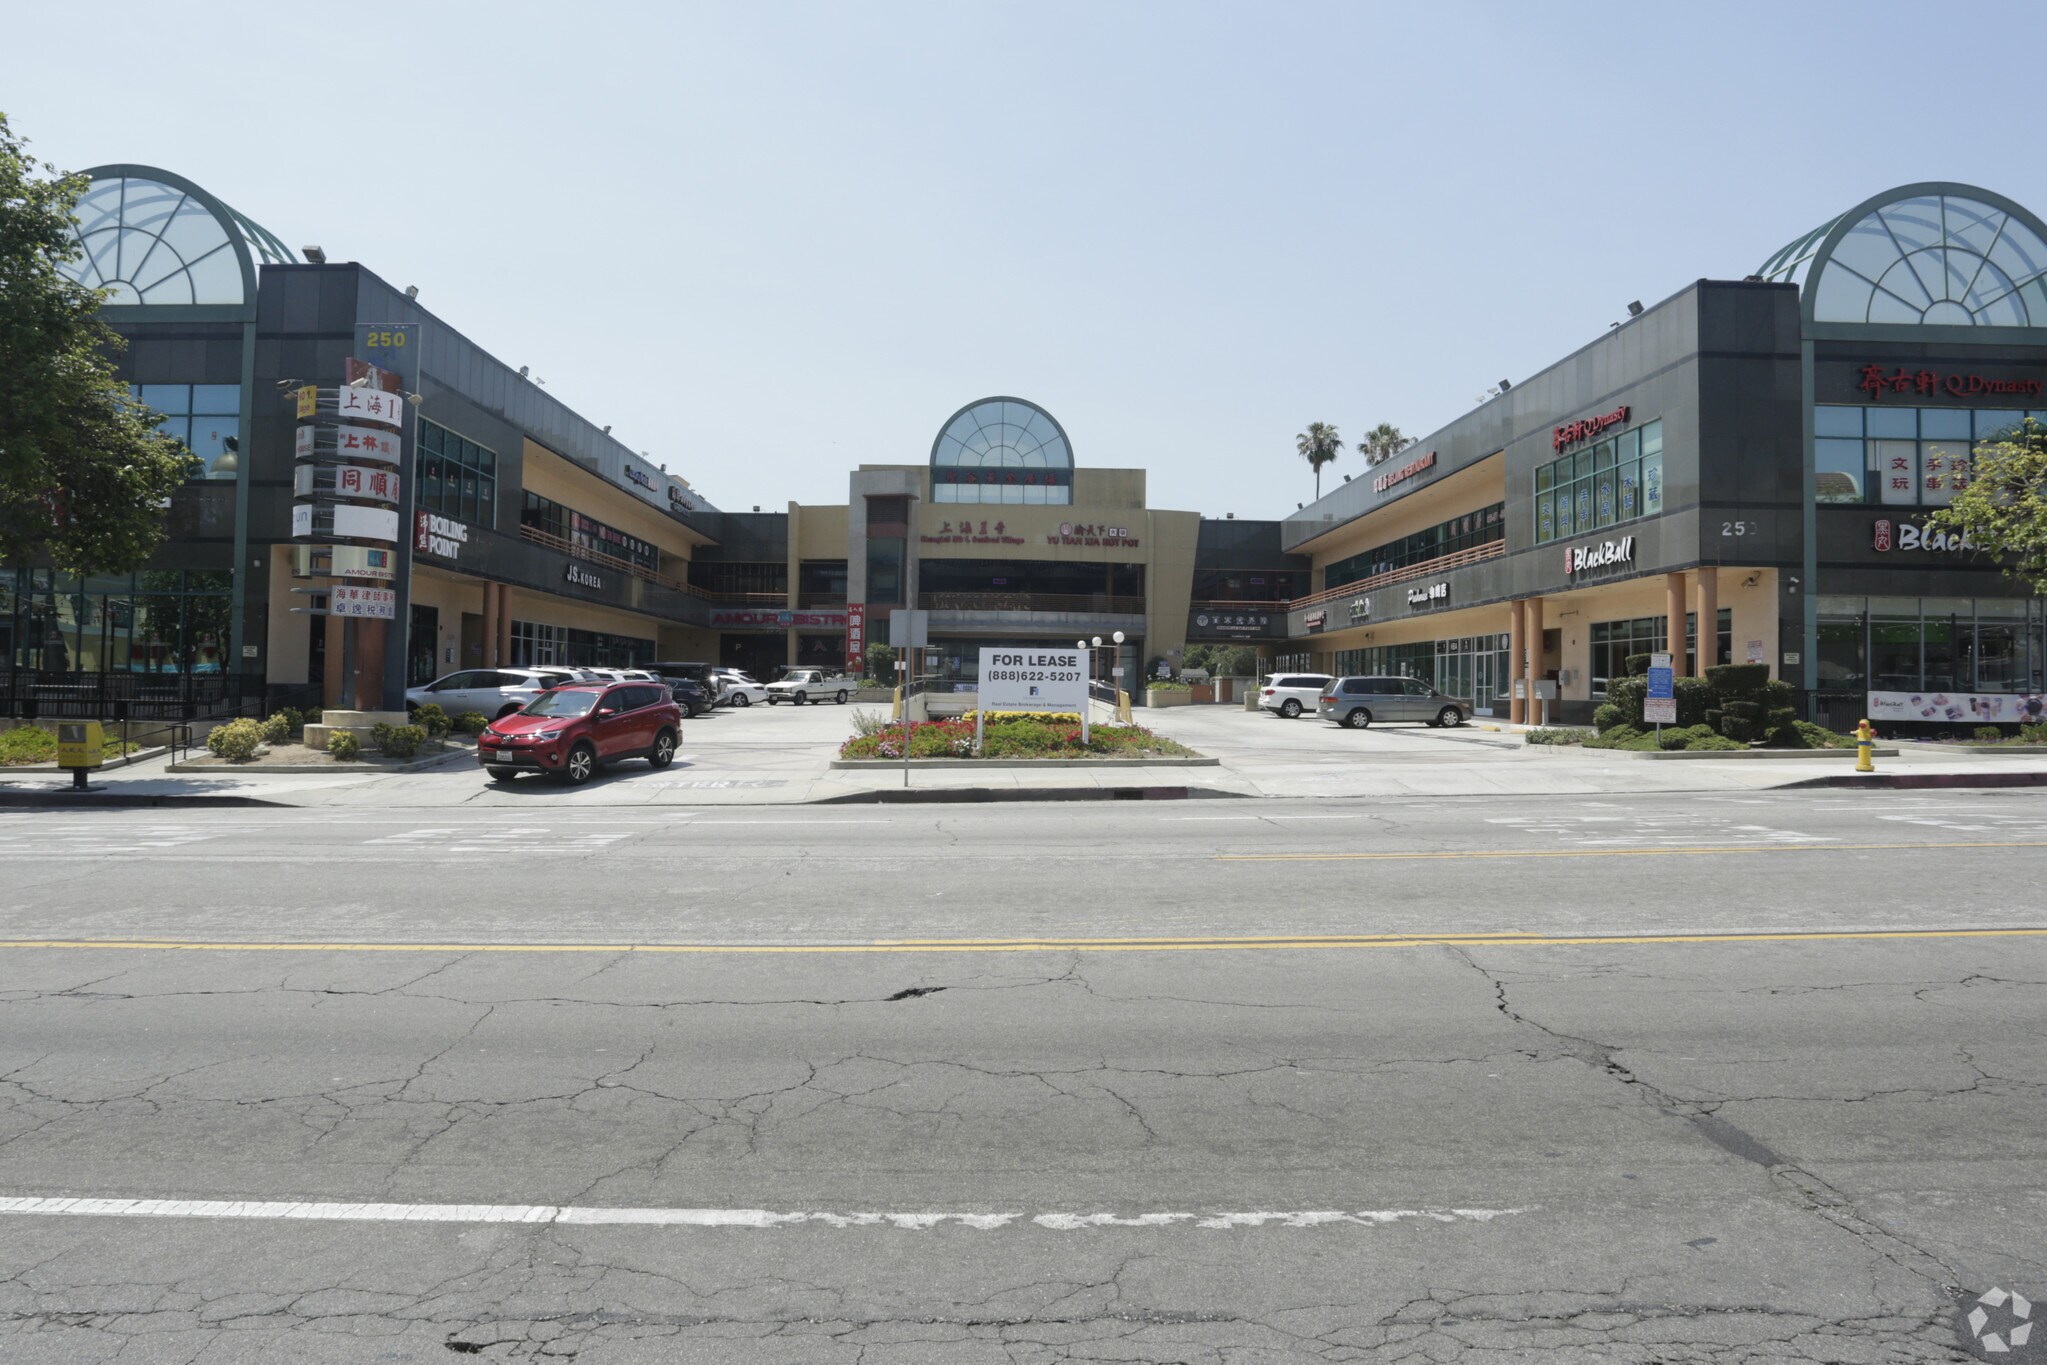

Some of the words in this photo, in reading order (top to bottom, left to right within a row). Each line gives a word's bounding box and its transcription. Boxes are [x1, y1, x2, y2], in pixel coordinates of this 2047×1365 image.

[367, 331, 406, 347] 250
[1946, 375, 1972, 397] Q
[1968, 375, 2044, 397] Dynasty
[1583, 418, 1595, 436] Q
[1592, 406, 1626, 431] Dynasty
[1891, 456, 1908, 490] 文玩
[429, 514, 467, 542] BOILING
[428, 534, 460, 559] POINT
[1122, 539, 1140, 548] POT
[1574, 536, 1632, 571] BlackBall
[344, 568, 378, 577] AMOUR
[711, 612, 779, 625] AMOUR
[791, 614, 848, 625] BISTR
[992, 654, 1023, 666] FOR
[1028, 655, 1077, 667] LEASE
[988, 670, 1081, 682] (888)622-5207
